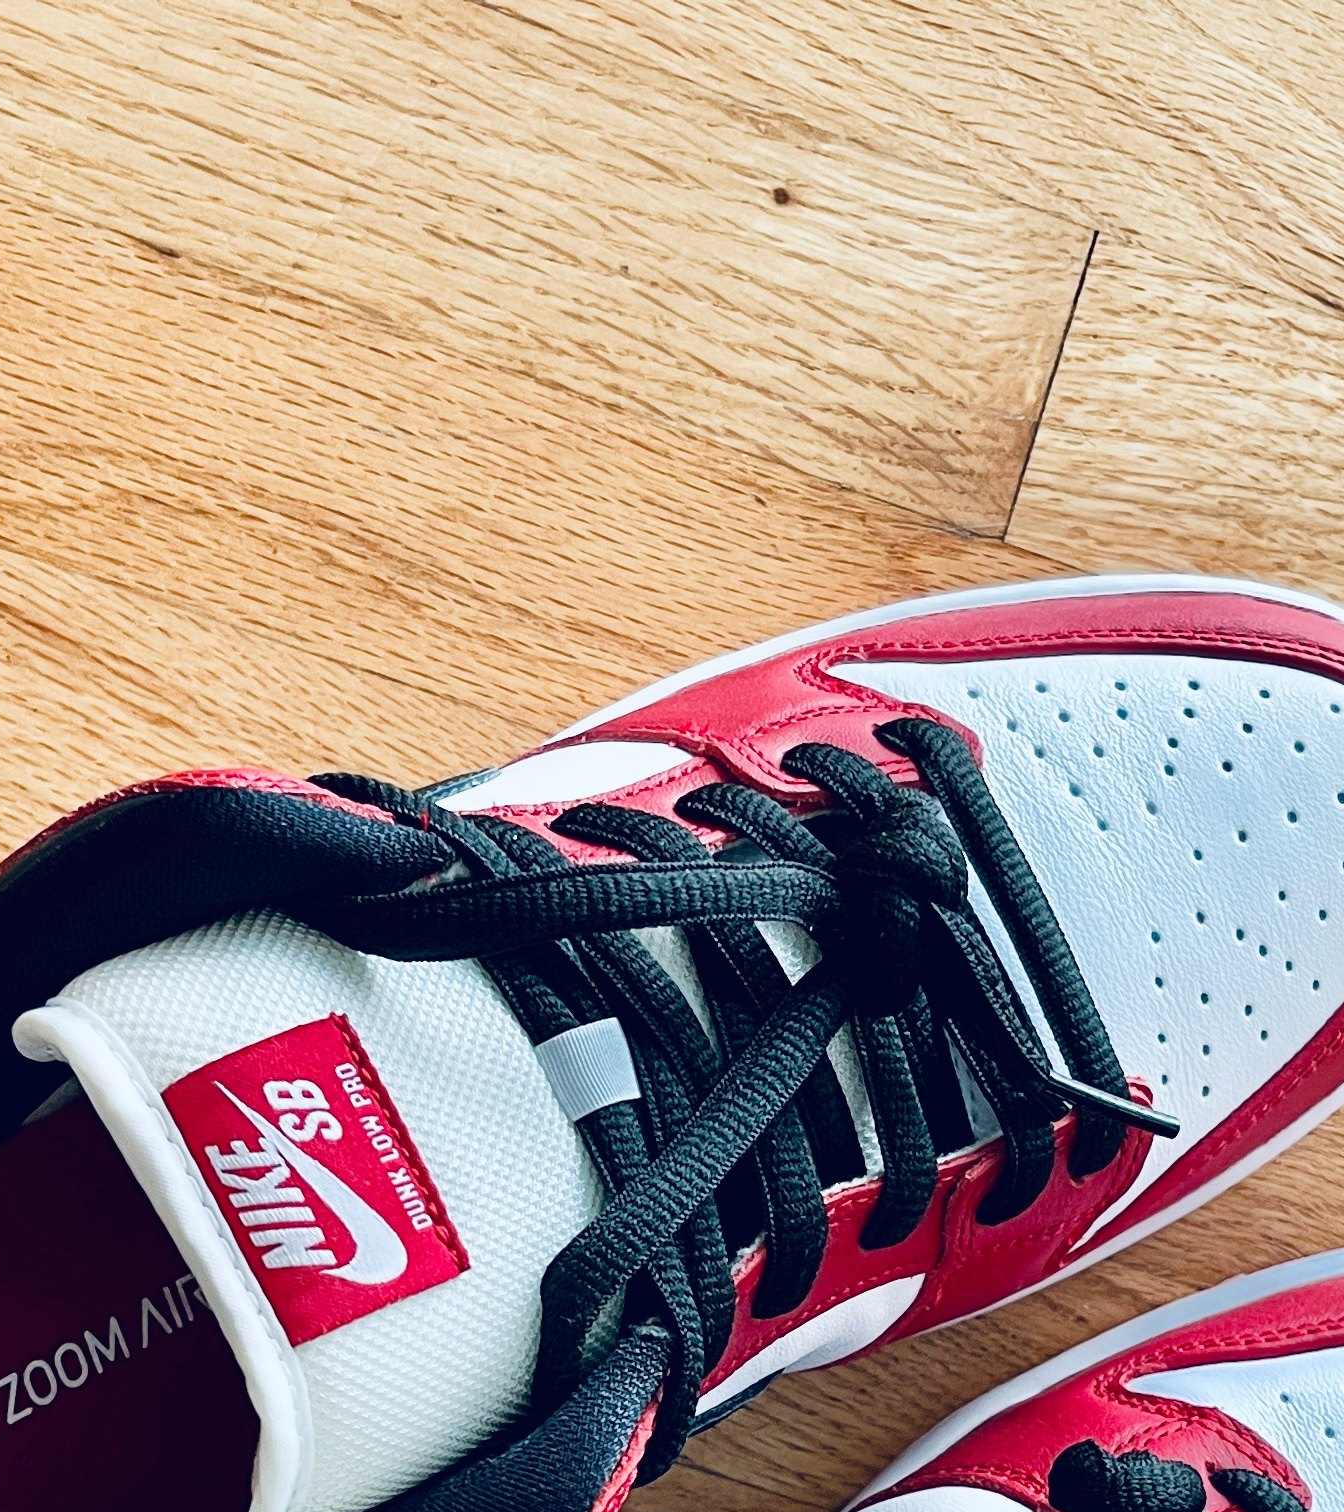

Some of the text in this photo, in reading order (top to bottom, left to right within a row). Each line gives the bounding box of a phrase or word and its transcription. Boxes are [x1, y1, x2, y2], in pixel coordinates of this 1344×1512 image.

[262, 1078, 344, 1143] SB
[335, 1062, 433, 1231] DUNK LOW PRO
[204, 1136, 338, 1269] NIKE
